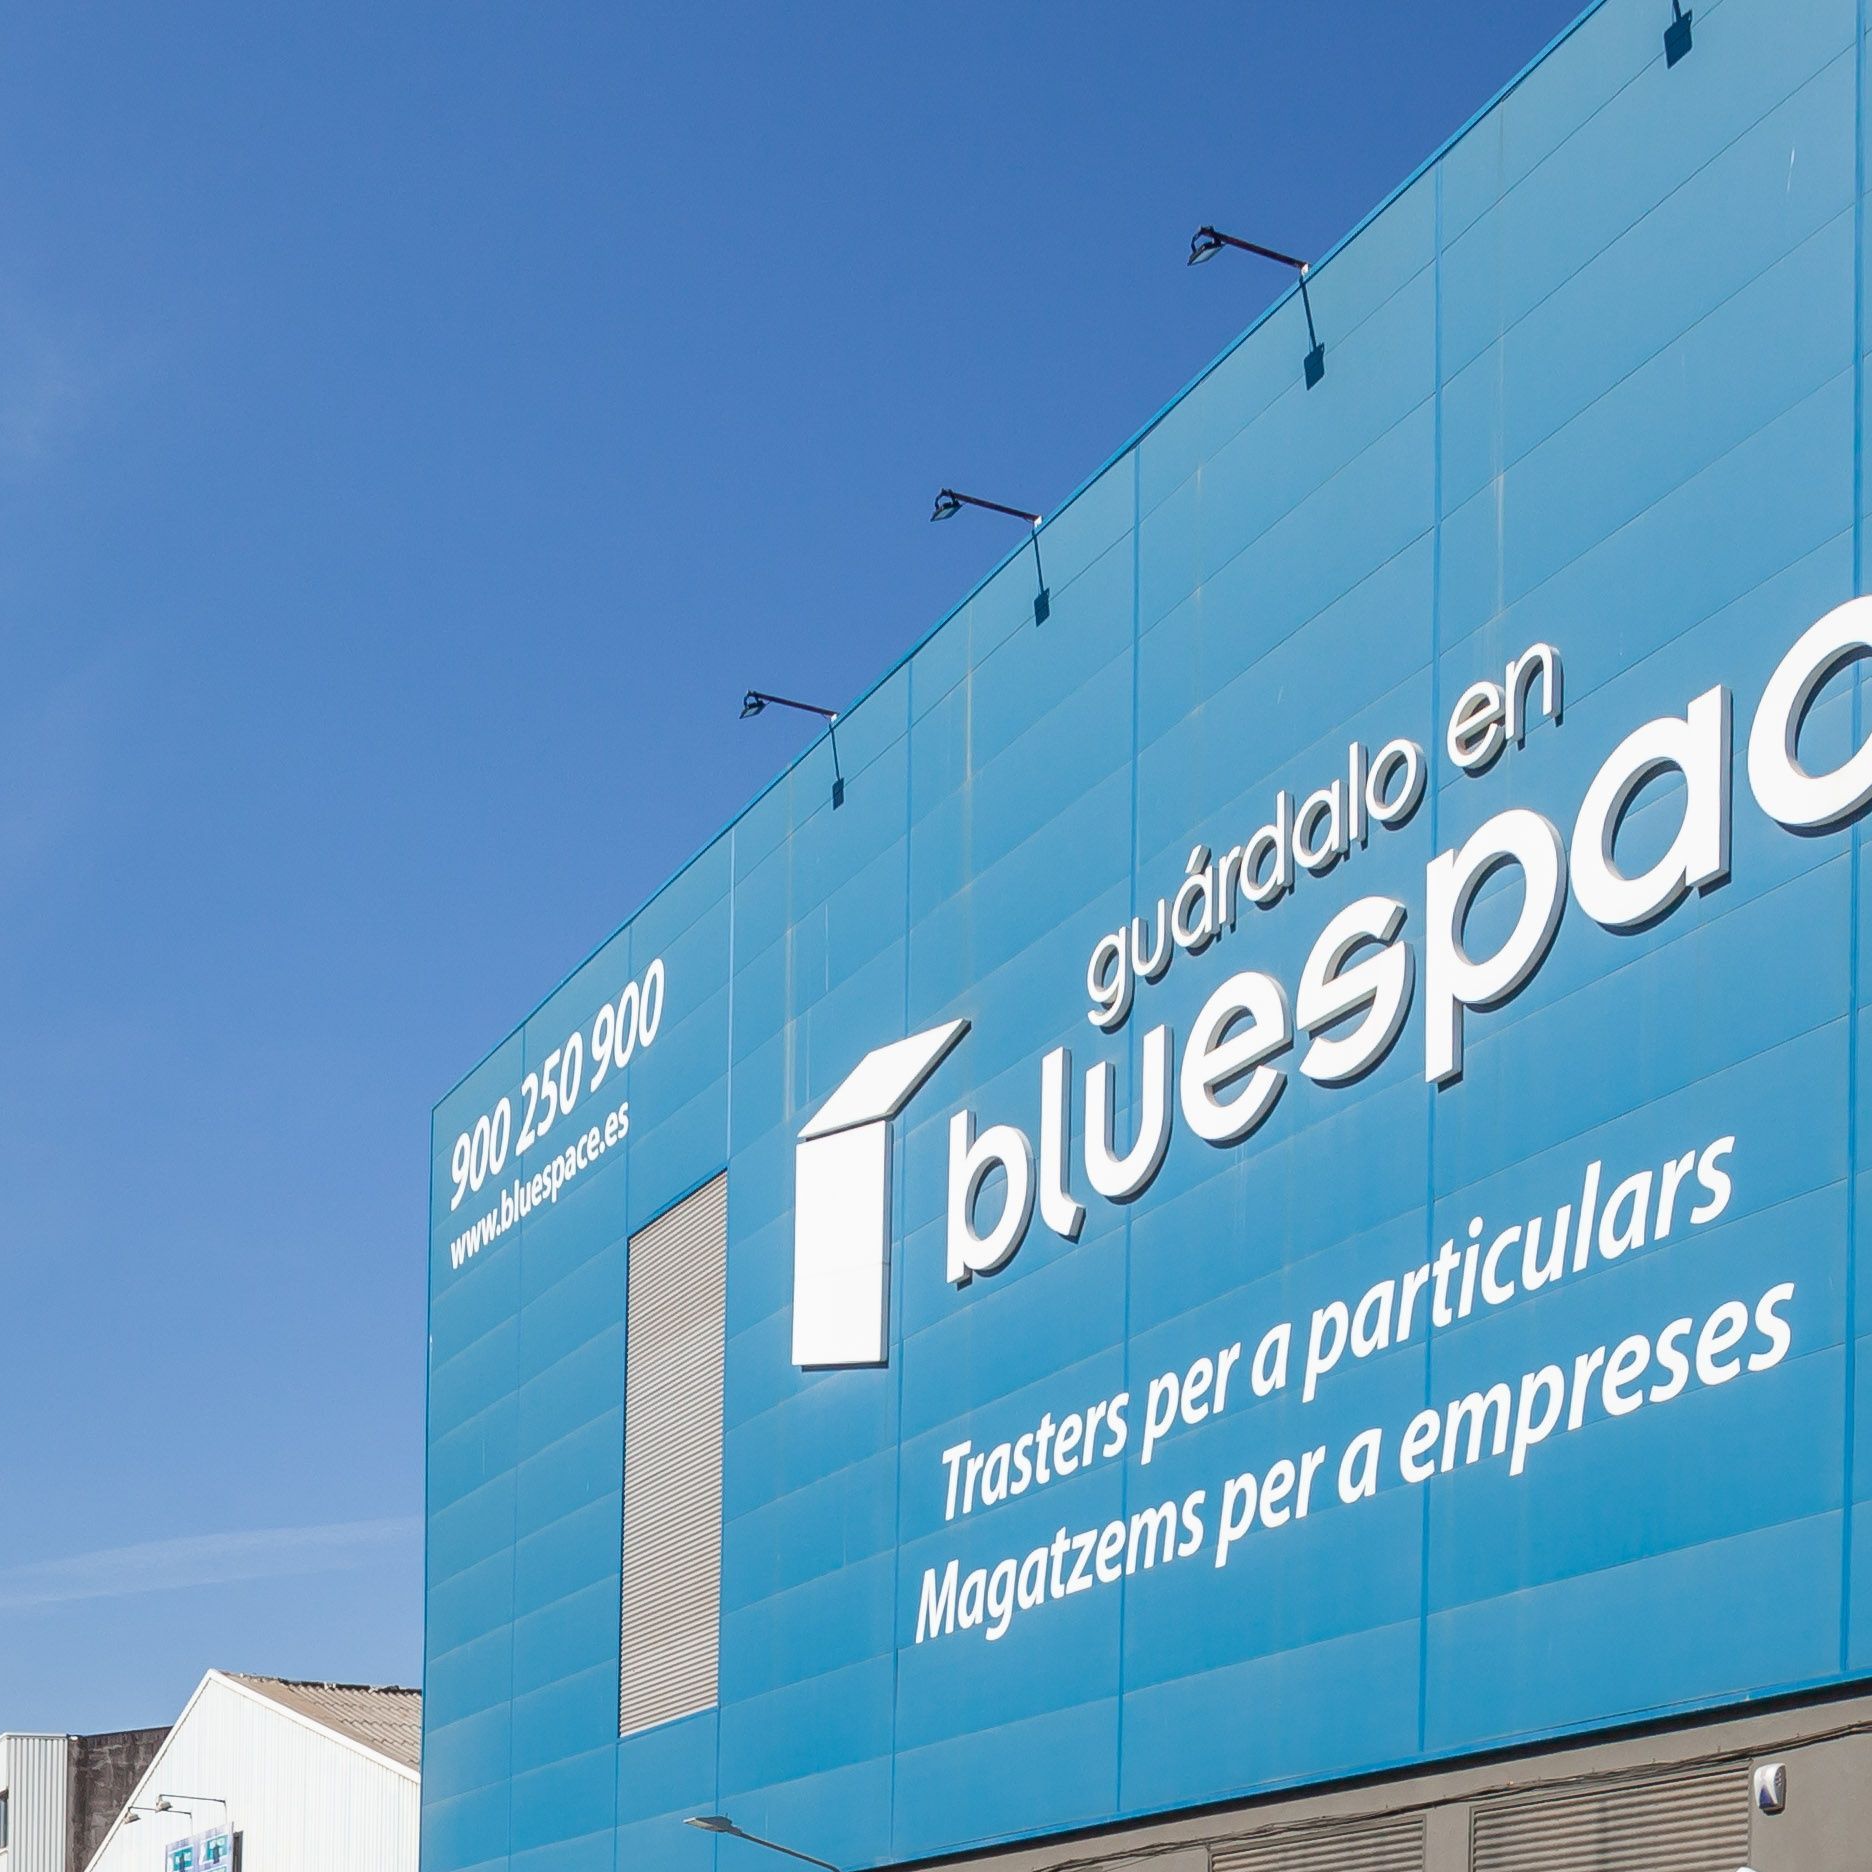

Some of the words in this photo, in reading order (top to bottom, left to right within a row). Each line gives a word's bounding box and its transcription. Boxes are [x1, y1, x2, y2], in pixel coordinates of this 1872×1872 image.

[1087, 734, 1425, 1030] guárdalo
[1447, 642, 1563, 776] en
[450, 1101, 512, 1212] 900
[515, 1031, 582, 1156] 250
[590, 958, 665, 1092] 900
[450, 1102, 629, 1269] www.bluespace.es
[915, 1497, 1205, 1644] Magatzems
[1216, 1449, 1326, 1567] per
[1339, 1427, 1379, 1504] a
[1397, 1283, 1796, 1476] empreses
[942, 1390, 1129, 1521] Trasters
[1141, 1343, 1240, 1464] per
[1251, 1323, 1292, 1390] a
[1302, 1135, 1738, 1402] particulars
